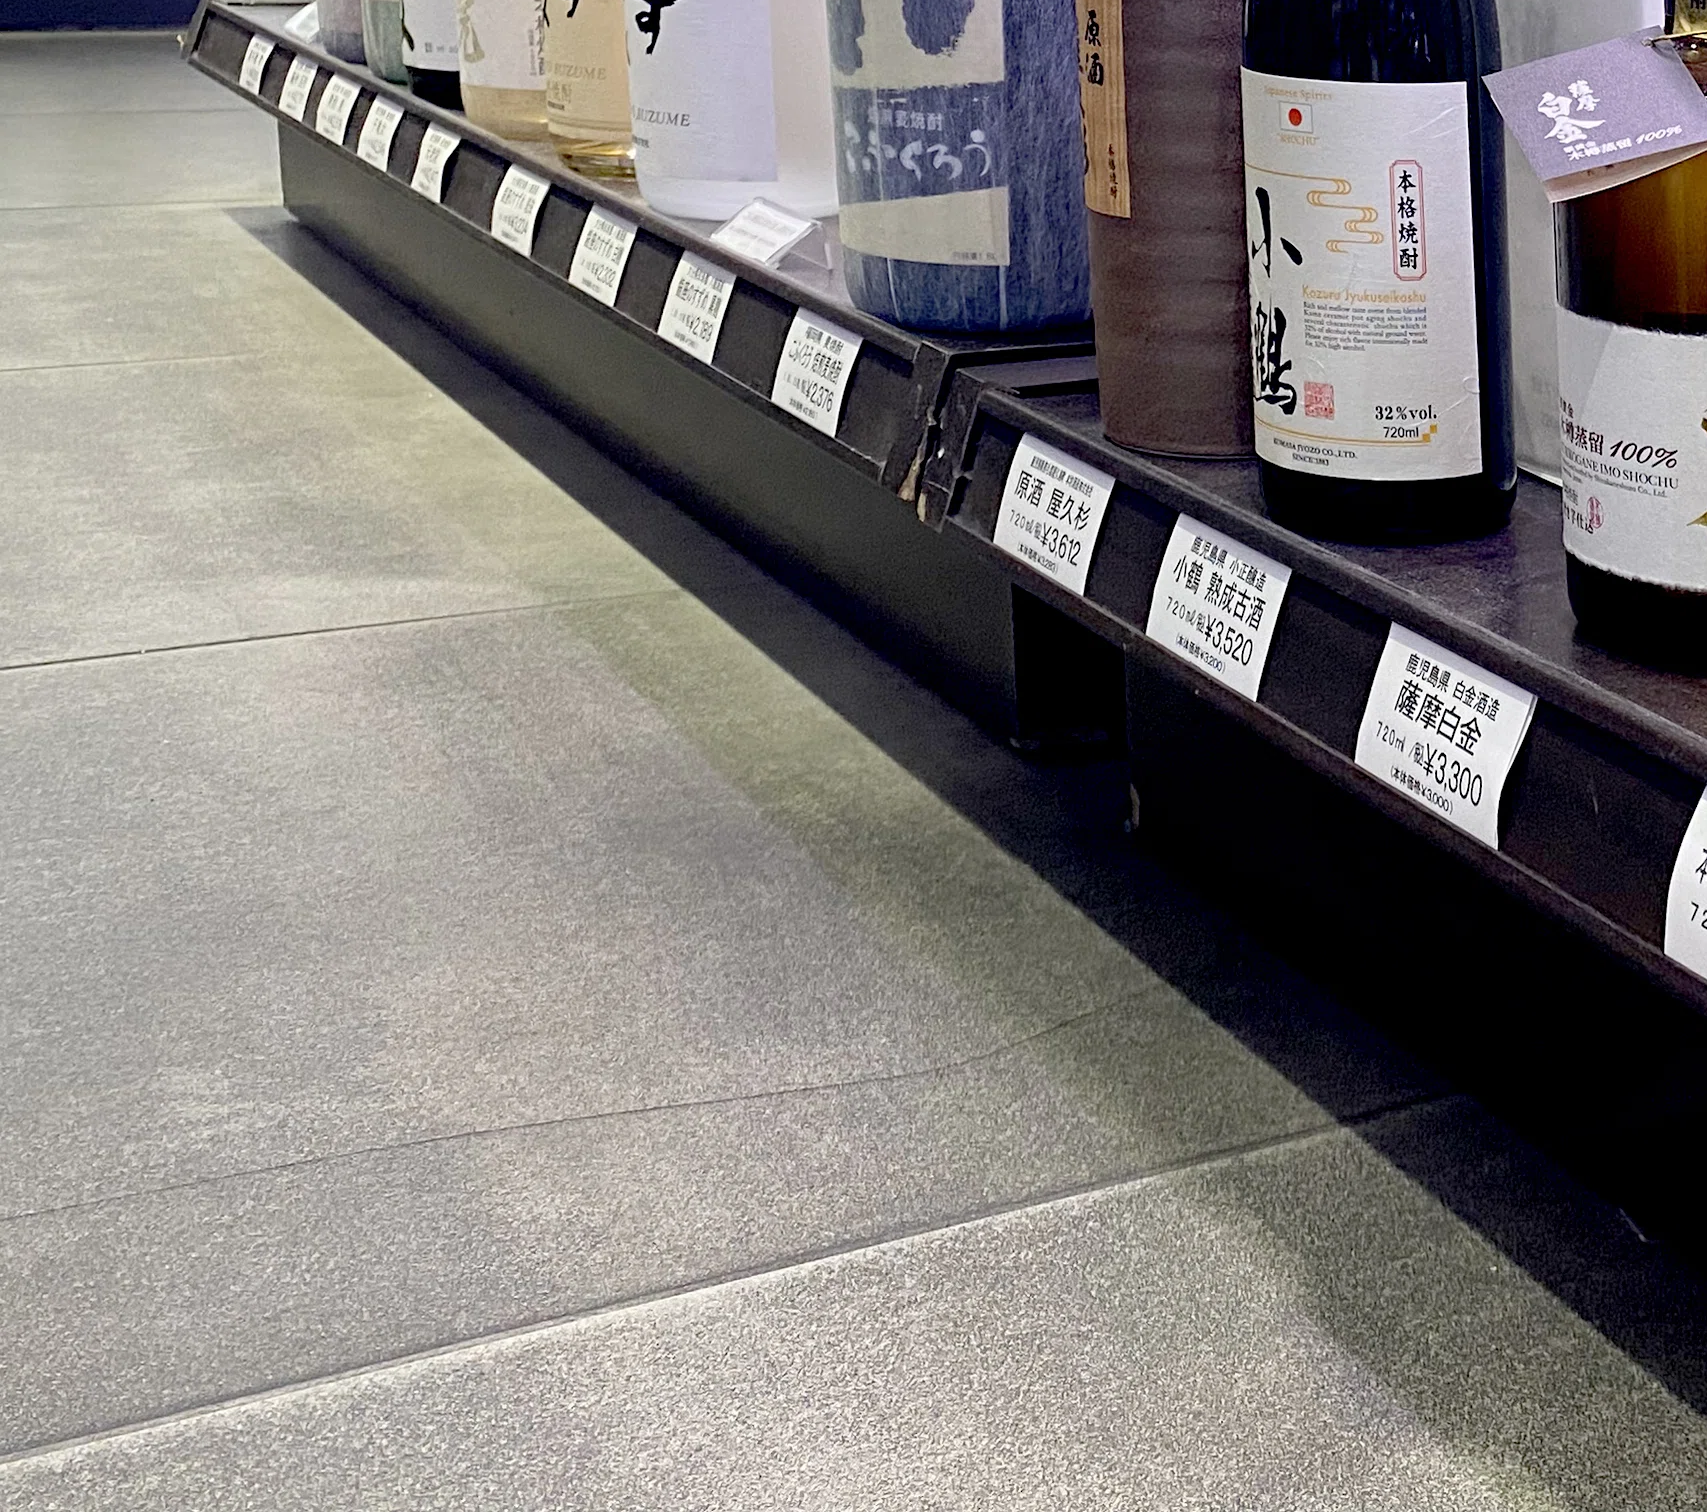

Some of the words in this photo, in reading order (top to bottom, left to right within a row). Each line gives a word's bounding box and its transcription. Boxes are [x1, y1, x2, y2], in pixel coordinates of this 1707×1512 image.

[1084, 9, 1104, 87] 原酒
[1537, 91, 1606, 144] 白金
[1396, 169, 1419, 271] 本格焼酎
[1383, 426, 1420, 438] 720ml
[1609, 440, 1678, 469] 100%
[1014, 470, 1046, 509] 原酒
[1046, 487, 1091, 531] 屋久杉
[1623, 471, 1679, 490] SHOCHU
[1190, 536, 1228, 569] 鹿児島県
[1204, 571, 1266, 631] 熟成古酒
[1394, 679, 1482, 756] 薩摩白金
[1405, 653, 1451, 693] 鹿児島県
[1452, 680, 1501, 722] 白金酒造
